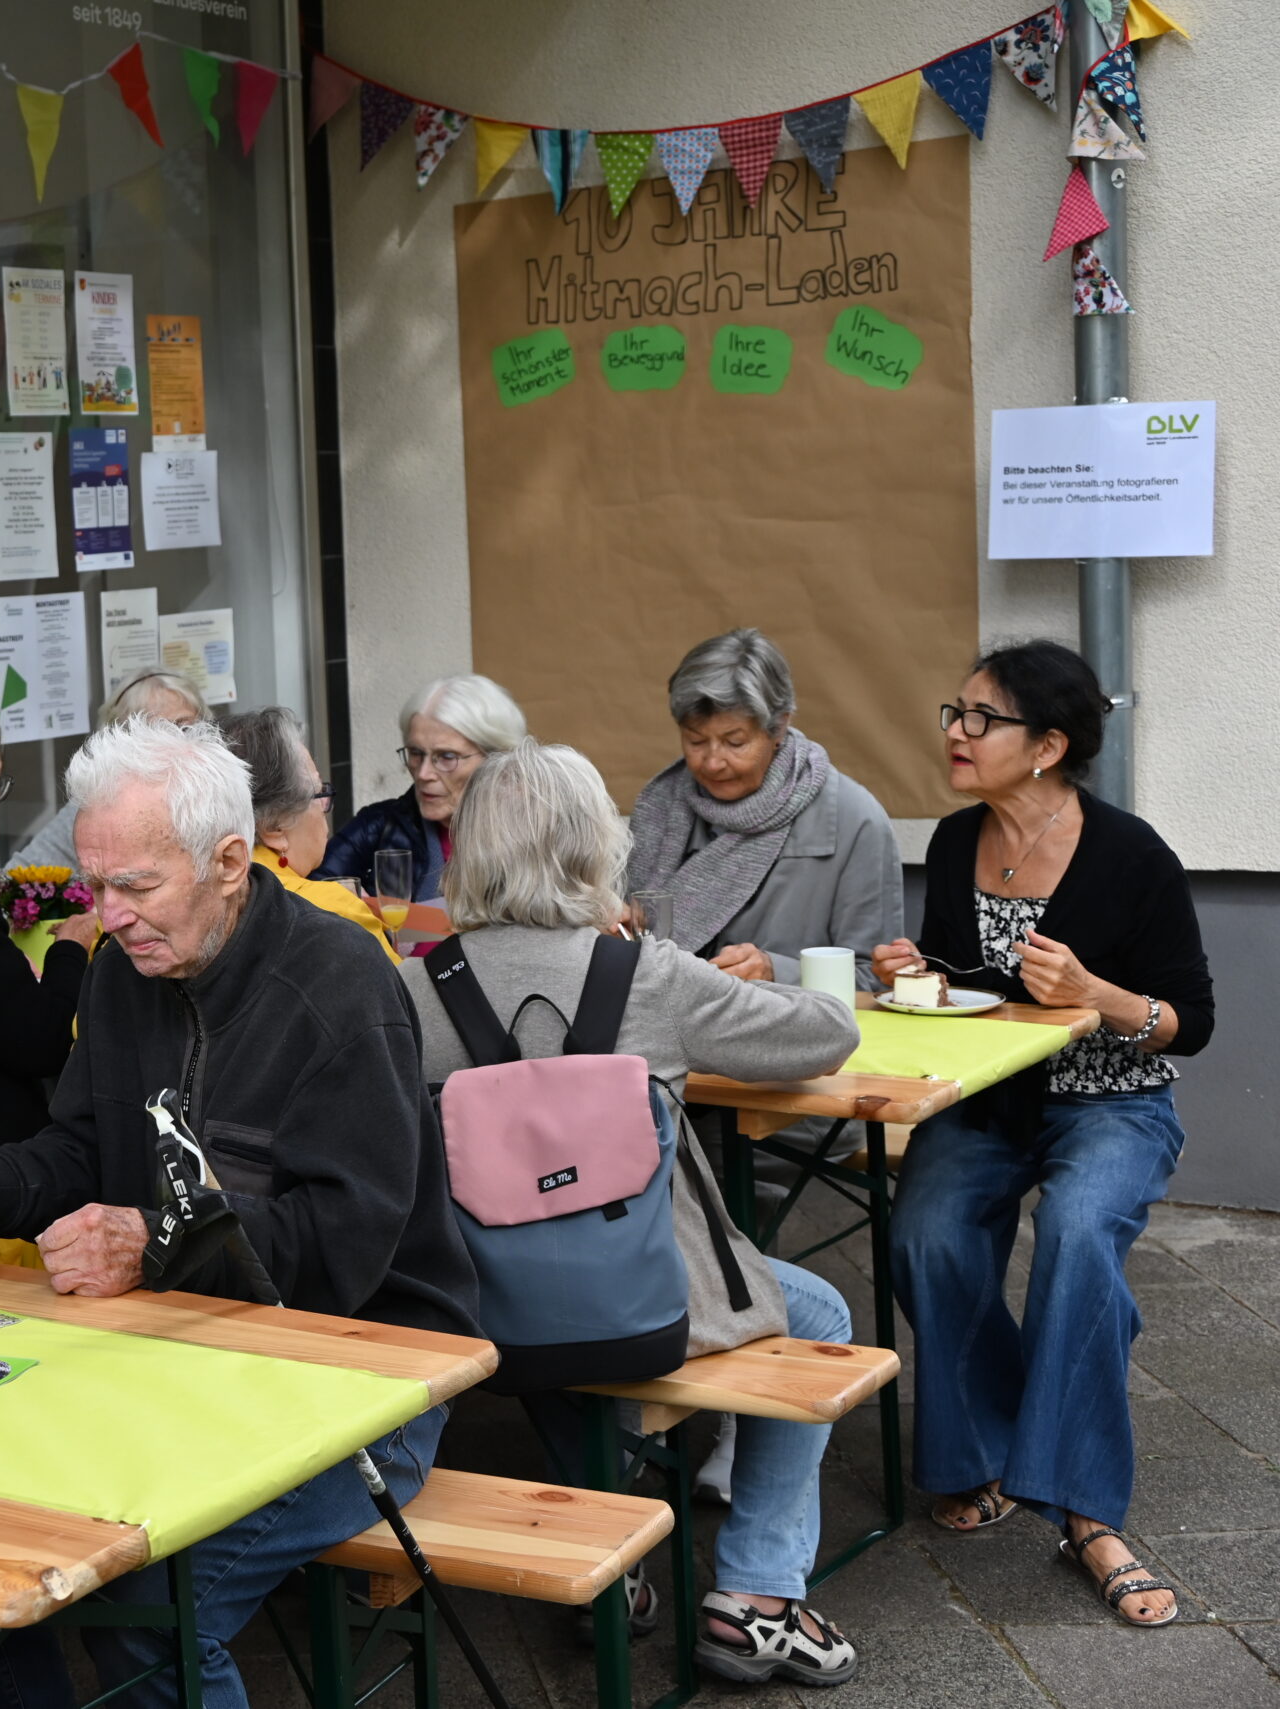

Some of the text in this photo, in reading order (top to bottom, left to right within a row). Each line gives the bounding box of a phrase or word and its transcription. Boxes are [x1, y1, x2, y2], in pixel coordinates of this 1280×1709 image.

[73, 5, 143, 31] seit 1849
[525, 229, 899, 326] Mitmach-Laden
[851, 309, 885, 338] Ihr
[623, 333, 650, 352] Ihr
[729, 331, 766, 354] Ihre
[508, 345, 536, 367] Ihr
[722, 355, 772, 379] Idee
[836, 334, 910, 385] Wunsch
[1003, 463, 1094, 476] Bitte beachten Sie:
[1002, 477, 1179, 490] Bei dieser Veranstaltung fotografieren
[1002, 492, 1163, 505] wir für unsere Öffentlichkeitsarbeit.
[166, 1161, 194, 1220] LEKI
